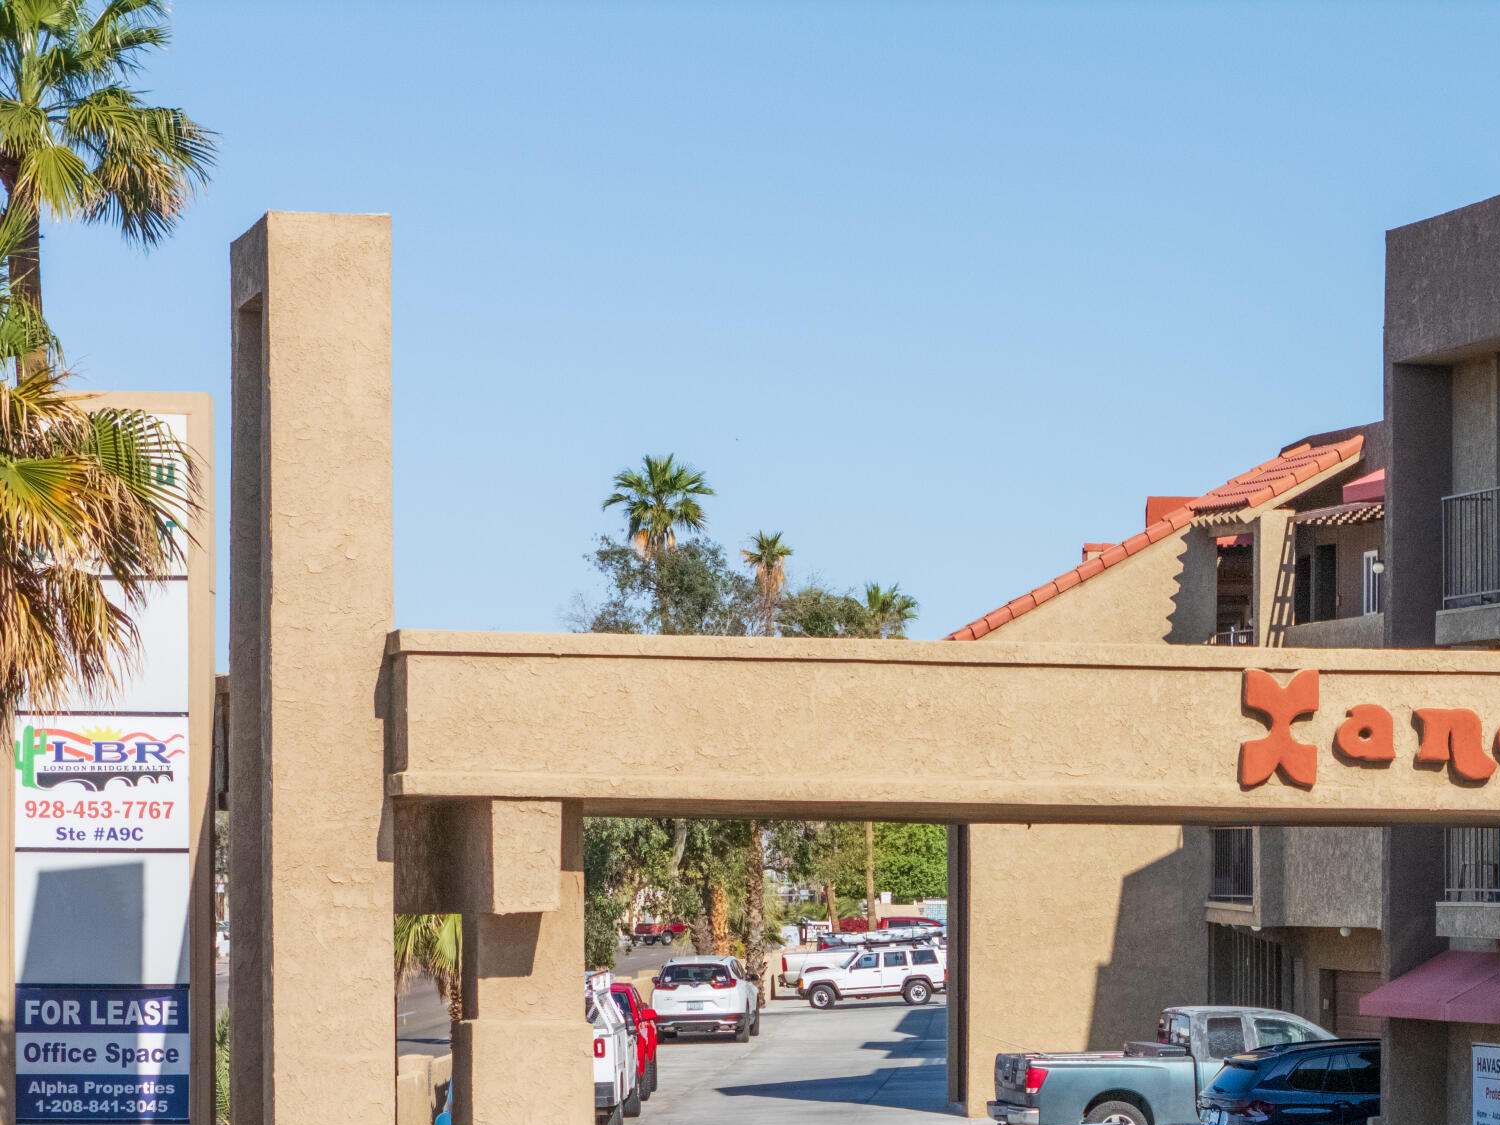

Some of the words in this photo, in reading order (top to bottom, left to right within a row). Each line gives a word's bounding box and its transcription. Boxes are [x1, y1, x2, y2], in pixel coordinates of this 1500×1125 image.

[52, 741, 171, 764] LBR
[25, 800, 175, 819] 928-453-7767
[56, 827, 86, 841] Ste
[94, 827, 144, 841] #A9C
[25, 1000, 81, 1025] FOR
[91, 1000, 178, 1025] LEASE
[24, 1043, 97, 1063] Office
[105, 1043, 179, 1068] Space
[28, 1081, 78, 1097] Alpha
[84, 1081, 175, 1097] Properties
[35, 1100, 168, 1113] 1-208-841-3045
